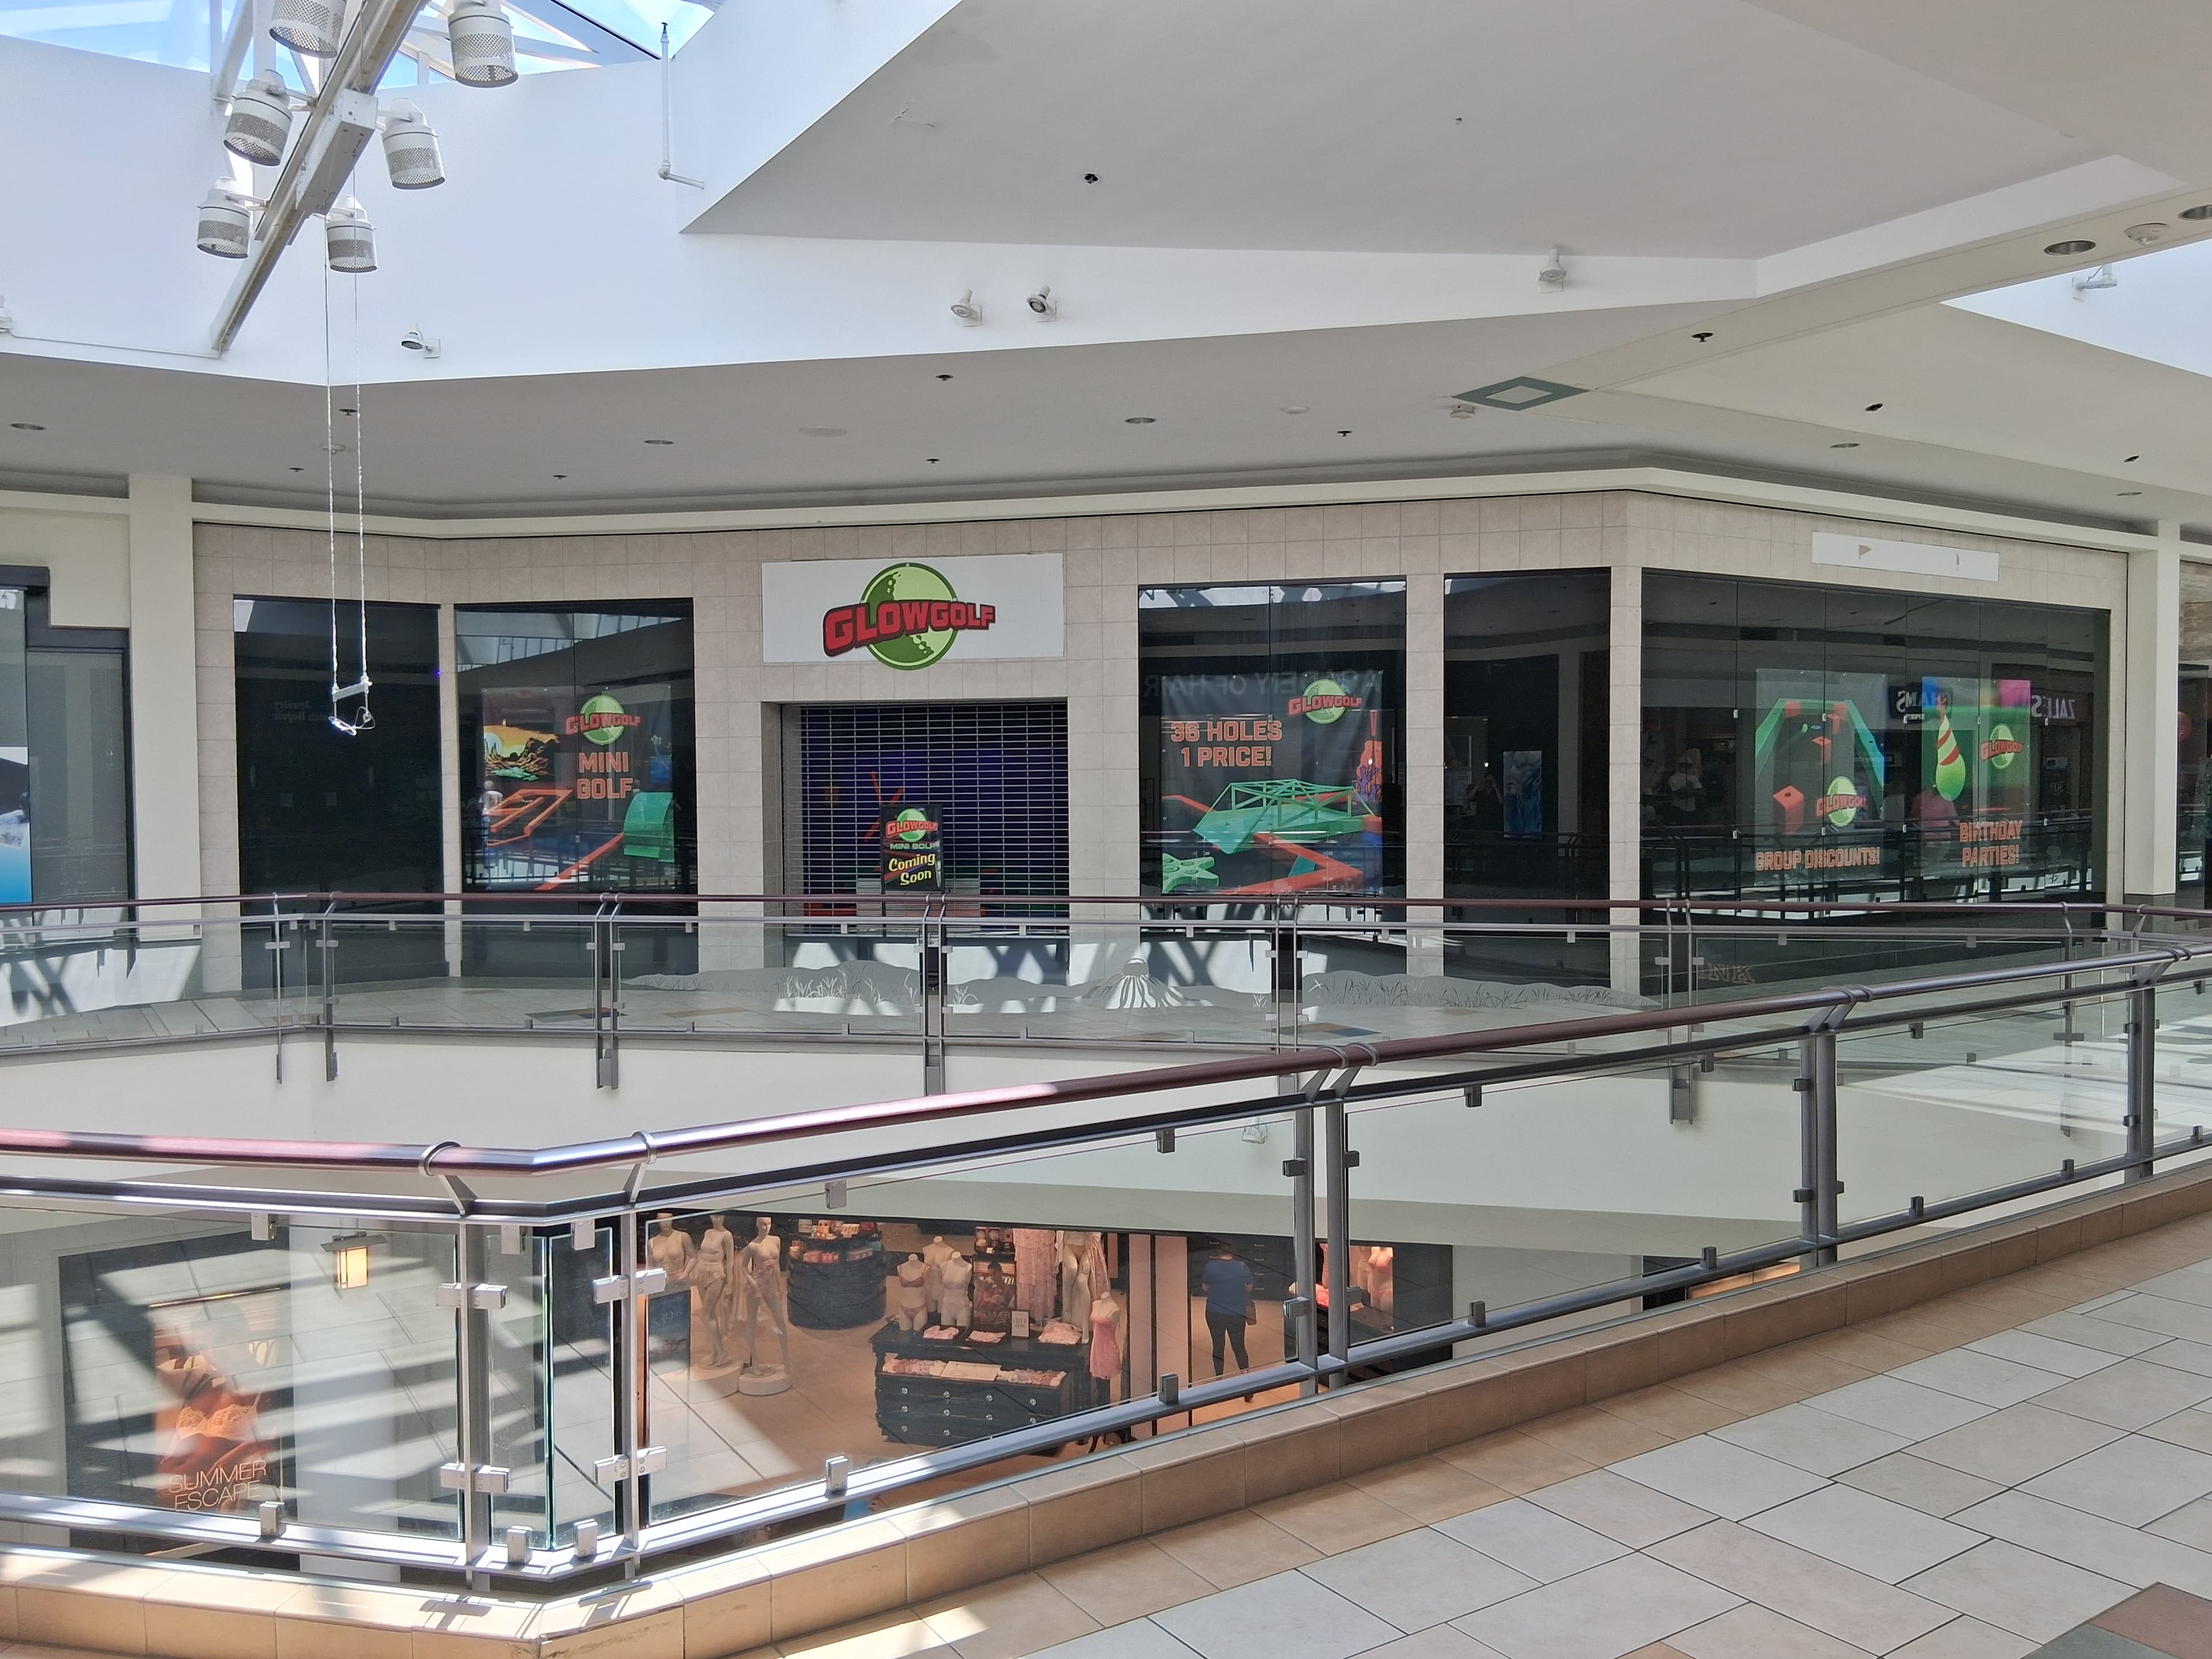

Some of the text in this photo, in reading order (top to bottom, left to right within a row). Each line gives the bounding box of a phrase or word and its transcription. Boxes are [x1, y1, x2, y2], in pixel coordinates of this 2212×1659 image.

[1171, 721, 1282, 742] 36 HOLES
[579, 752, 629, 773] MINI
[1180, 746, 1272, 767] 1 PRICE!
[577, 778, 633, 799] GOLF
[1960, 820, 2022, 842] BIRTHDAY
[888, 853, 935, 872] Coming
[1756, 847, 1880, 871] GROUP DISCOUNTS!
[1962, 844, 2019, 868] PARTIES!
[900, 870, 931, 885] Soon
[168, 1460, 267, 1494] SUMMER
[175, 1480, 260, 1512] ESCAPE
